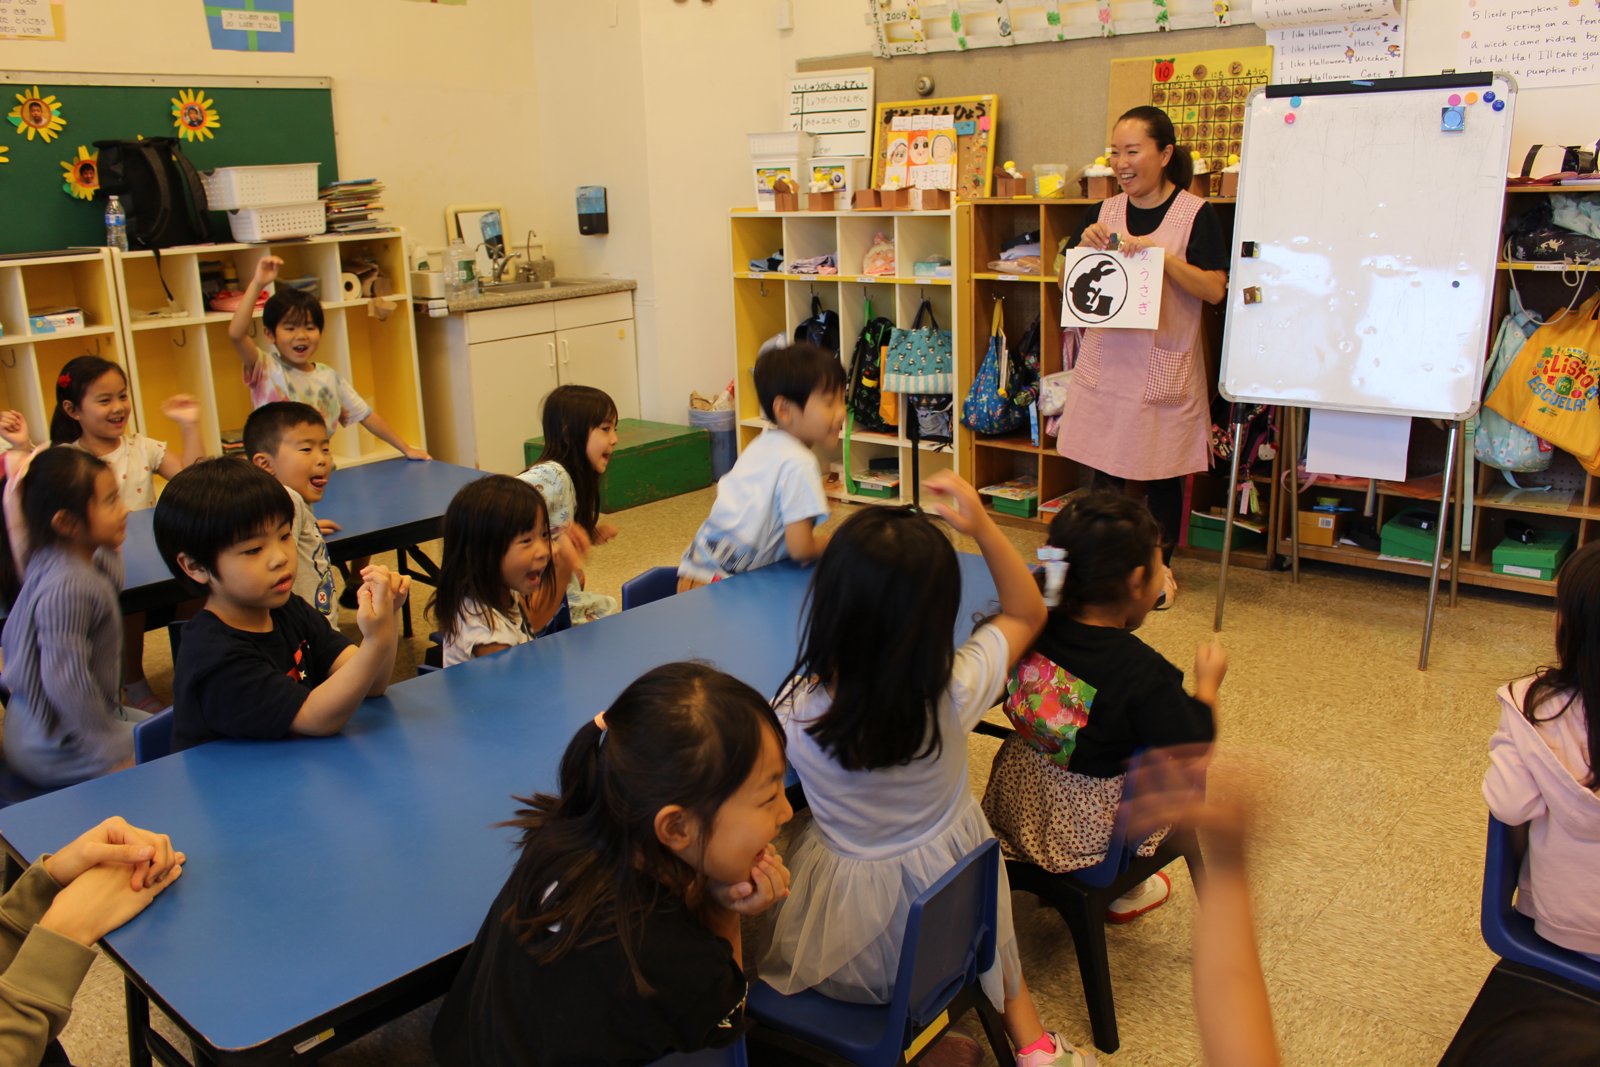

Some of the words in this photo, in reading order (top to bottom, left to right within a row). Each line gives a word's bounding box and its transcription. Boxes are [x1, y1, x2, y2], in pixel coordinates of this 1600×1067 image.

[886, 11, 907, 21] 2009
[1277, 8, 1291, 17] like
[1297, 4, 1332, 14] Halloween
[1472, 11, 1480, 20] 5
[1485, 9, 1507, 18] little
[1511, 5, 1559, 19] pumpkins
[1291, 29, 1305, 39] like
[1308, 28, 1343, 39] Halloween
[1351, 23, 1381, 33] Candies
[1506, 22, 1541, 32] sitting
[1291, 43, 1305, 53] like
[1308, 41, 1341, 52] Halloween
[1354, 39, 1375, 48] Hats
[1484, 40, 1508, 48] witch
[1545, 35, 1577, 44] riding
[1586, 31, 1598, 42] by
[1290, 60, 1305, 69] like
[1309, 56, 1346, 67] Halloween
[1355, 54, 1390, 63] Witches
[1512, 53, 1531, 61] Ha!
[1538, 50, 1553, 60] I'll
[1556, 51, 1578, 59] take
[1582, 50, 1600, 60] you
[1158, 66, 1170, 78] 10
[1361, 69, 1381, 79] Cats
[1526, 65, 1566, 77] pumpkin
[1571, 63, 1594, 75] pie!
[1138, 267, 1151, 316] うさぎ
[1527, 375, 1587, 412] ESCUELA!
